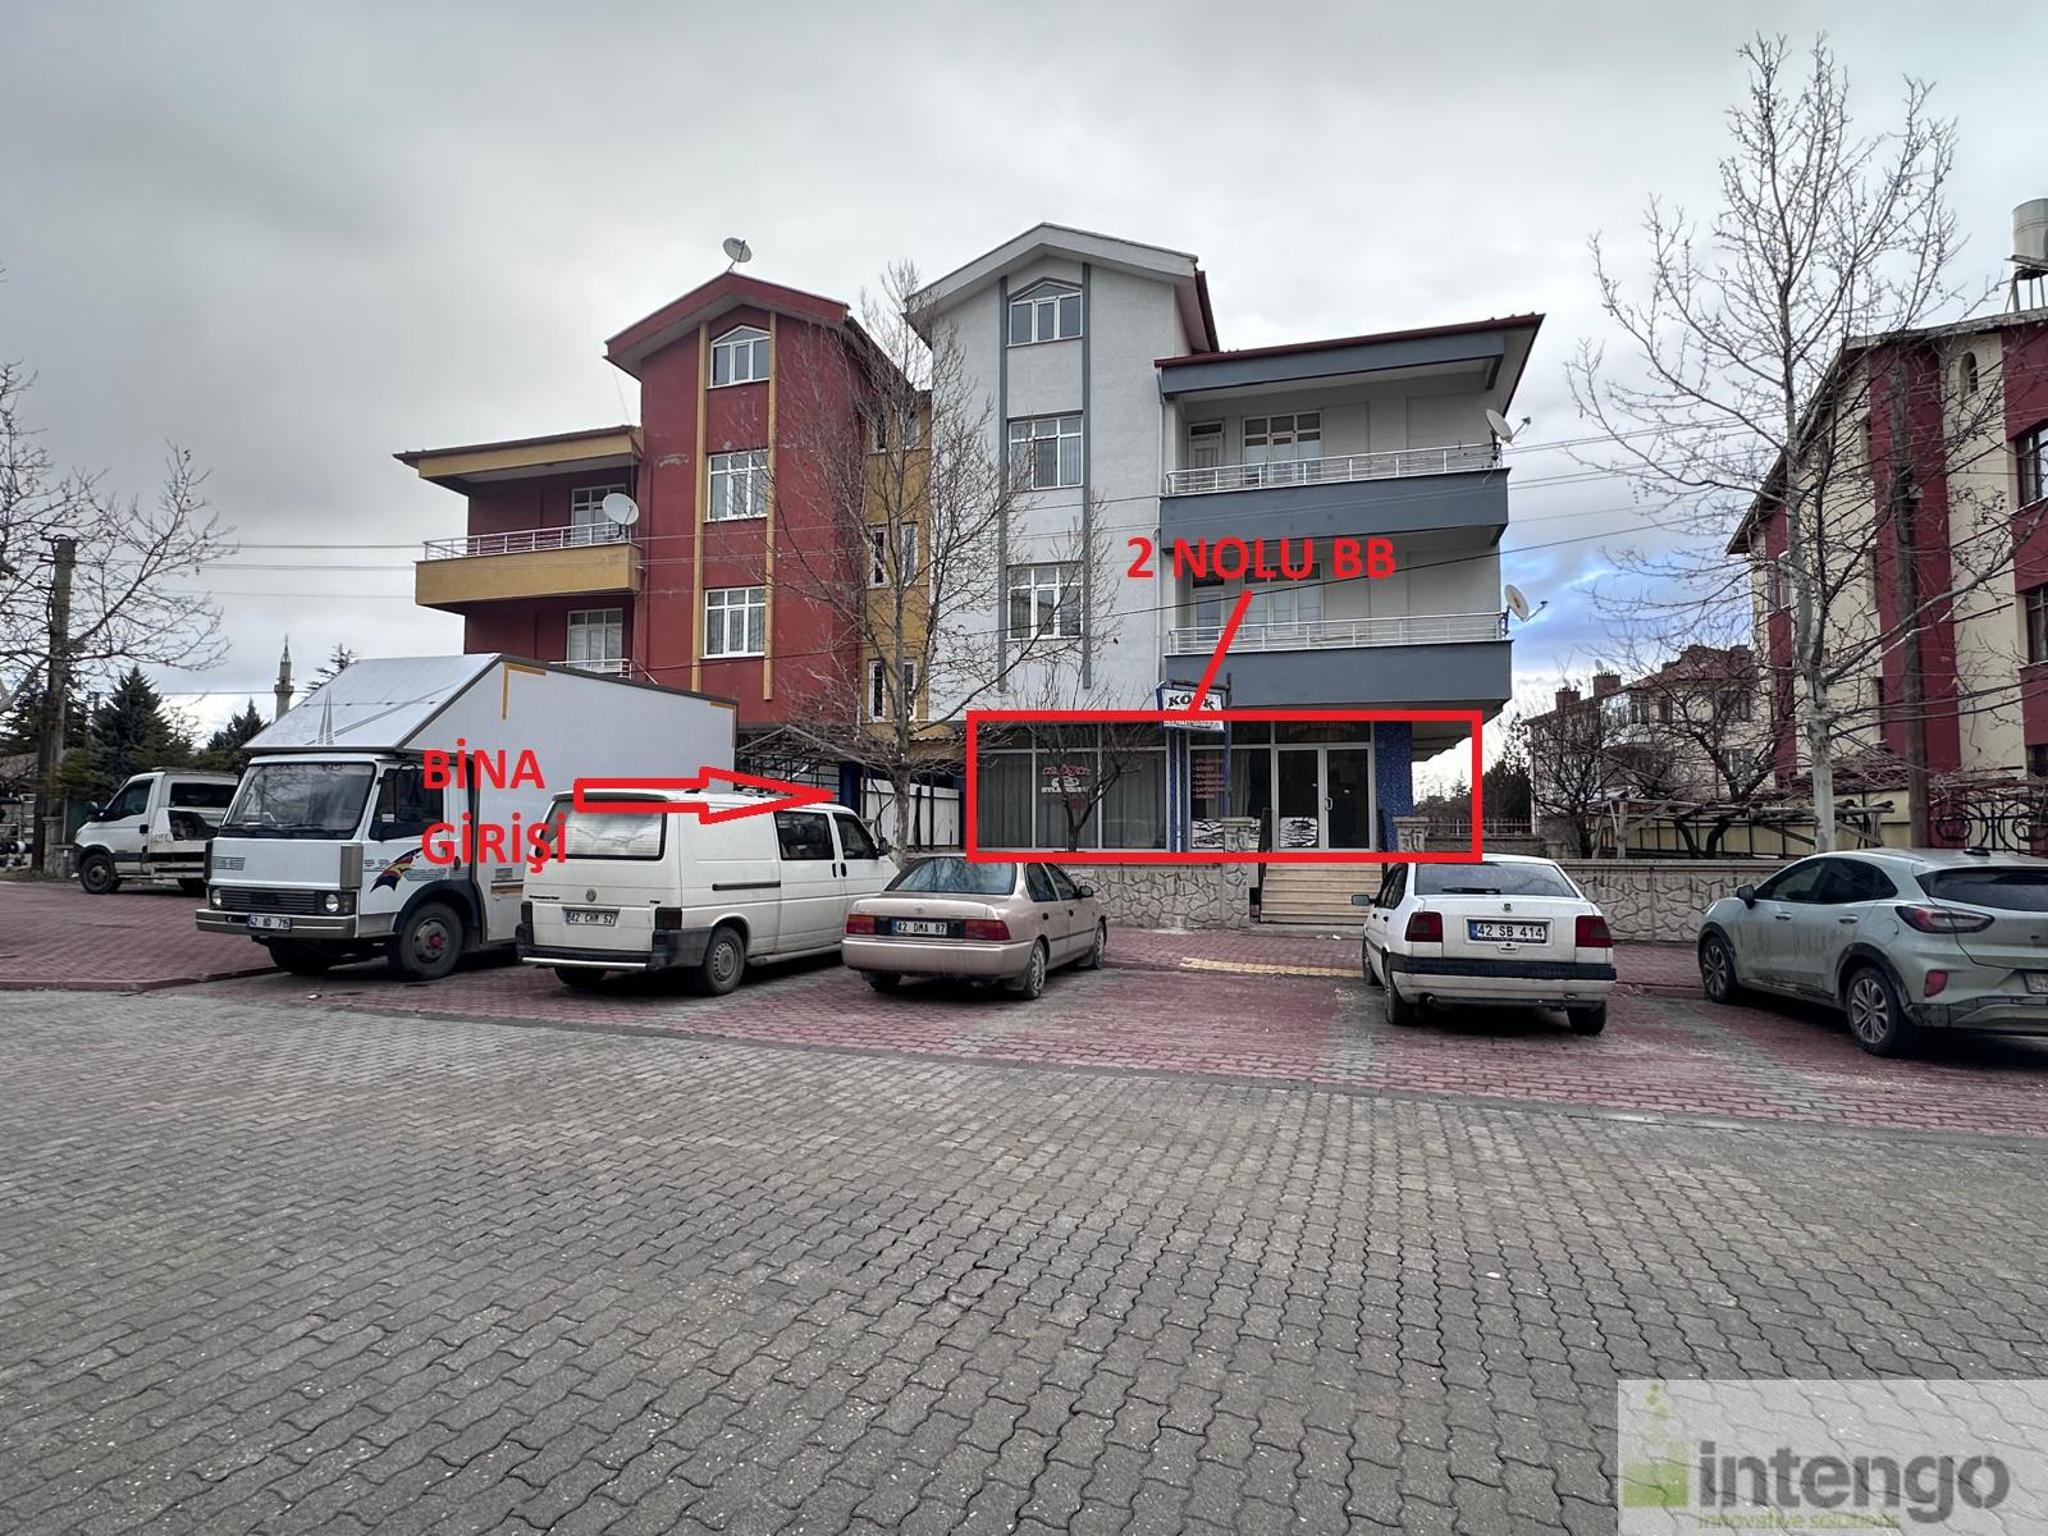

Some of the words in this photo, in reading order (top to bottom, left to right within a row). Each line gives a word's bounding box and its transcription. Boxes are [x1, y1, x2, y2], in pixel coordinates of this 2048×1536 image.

[897, 921, 908, 931] 42
[1477, 924, 1493, 936] 42
[1499, 925, 1514, 937] SB
[1520, 926, 1543, 937] 414
